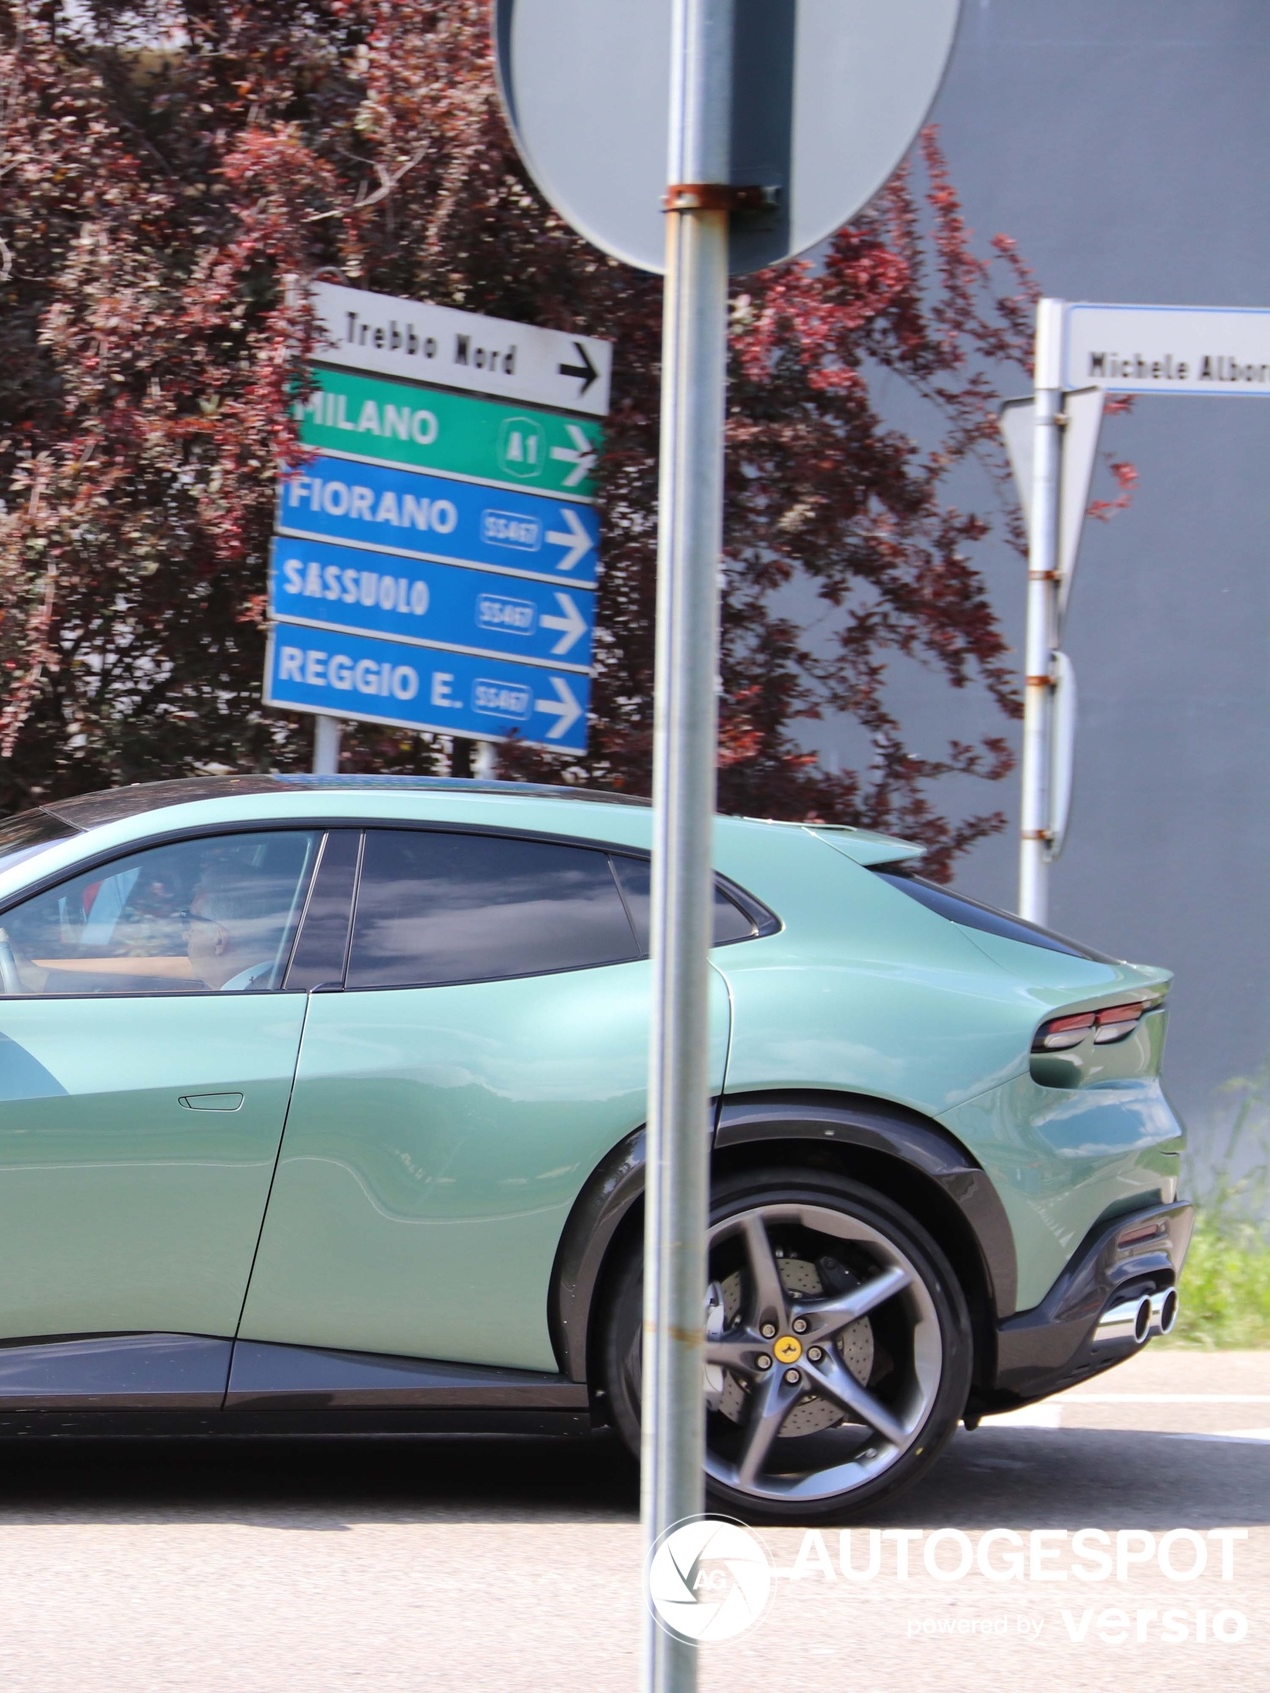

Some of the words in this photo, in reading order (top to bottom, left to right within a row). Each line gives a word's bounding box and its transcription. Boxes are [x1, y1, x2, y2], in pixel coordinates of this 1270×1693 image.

[345, 311, 438, 359] Trebbo
[453, 332, 518, 376] Nord
[1088, 352, 1190, 380] Michele
[1198, 355, 1270, 383] Albor
[504, 431, 539, 465] A1
[288, 475, 458, 534] FIORANO
[282, 559, 430, 616] SASSUOLO
[278, 646, 420, 701] REGGIO
[431, 672, 464, 709] E.
